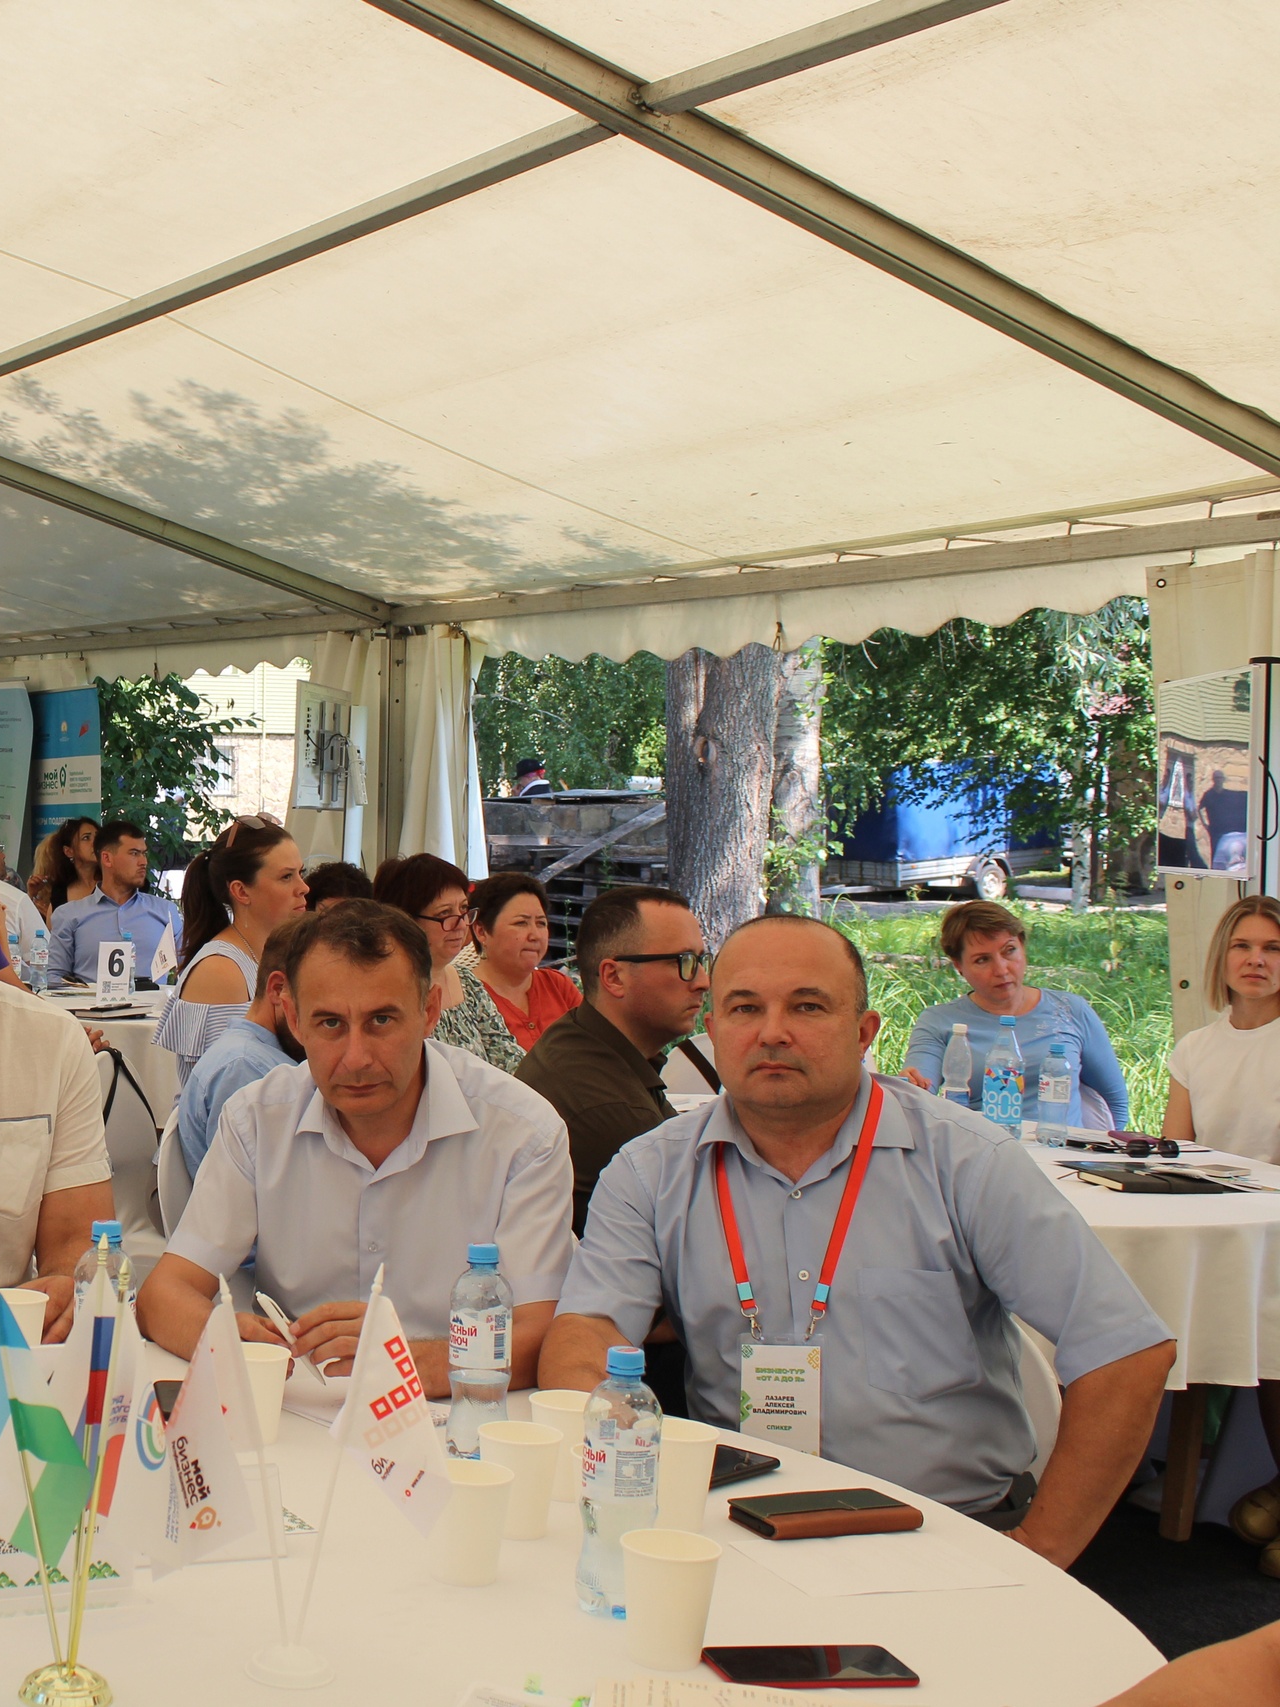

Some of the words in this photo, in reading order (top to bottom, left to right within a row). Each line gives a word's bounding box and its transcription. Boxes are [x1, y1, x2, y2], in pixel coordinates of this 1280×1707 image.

[108, 948, 125, 977] 6
[781, 1375, 794, 1383] ДО
[752, 1408, 807, 1416] ВЛАДИМИРОВИЧ
[176, 1436, 199, 1506] бизнес
